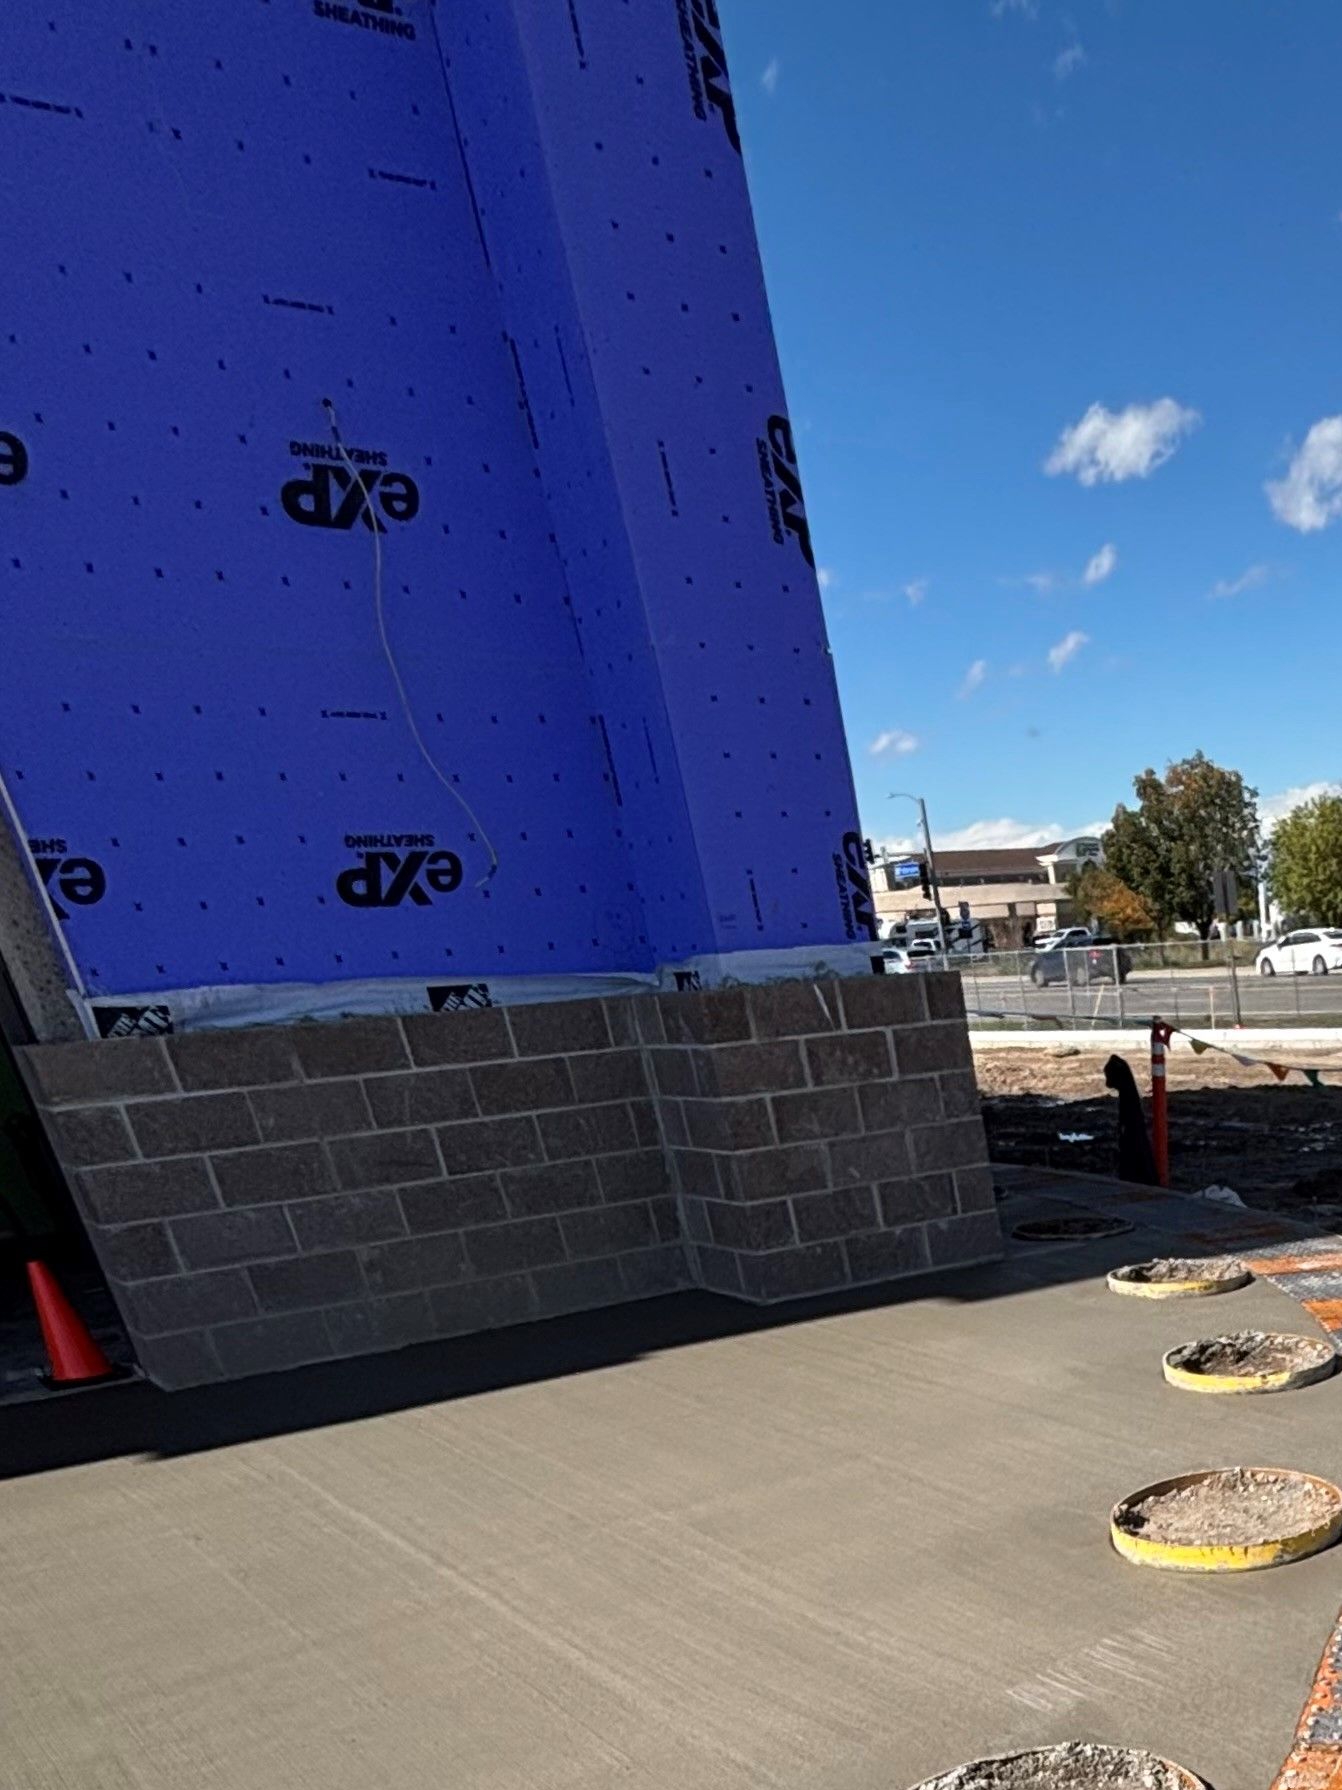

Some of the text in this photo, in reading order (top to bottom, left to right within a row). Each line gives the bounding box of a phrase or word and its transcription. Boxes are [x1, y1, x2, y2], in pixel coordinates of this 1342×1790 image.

[313, 0, 416, 41] SHEATHING
[289, 441, 388, 466] SHEATHING
[281, 463, 420, 533] eXP
[344, 834, 435, 848] SHEATHING
[336, 850, 463, 907] eXP
